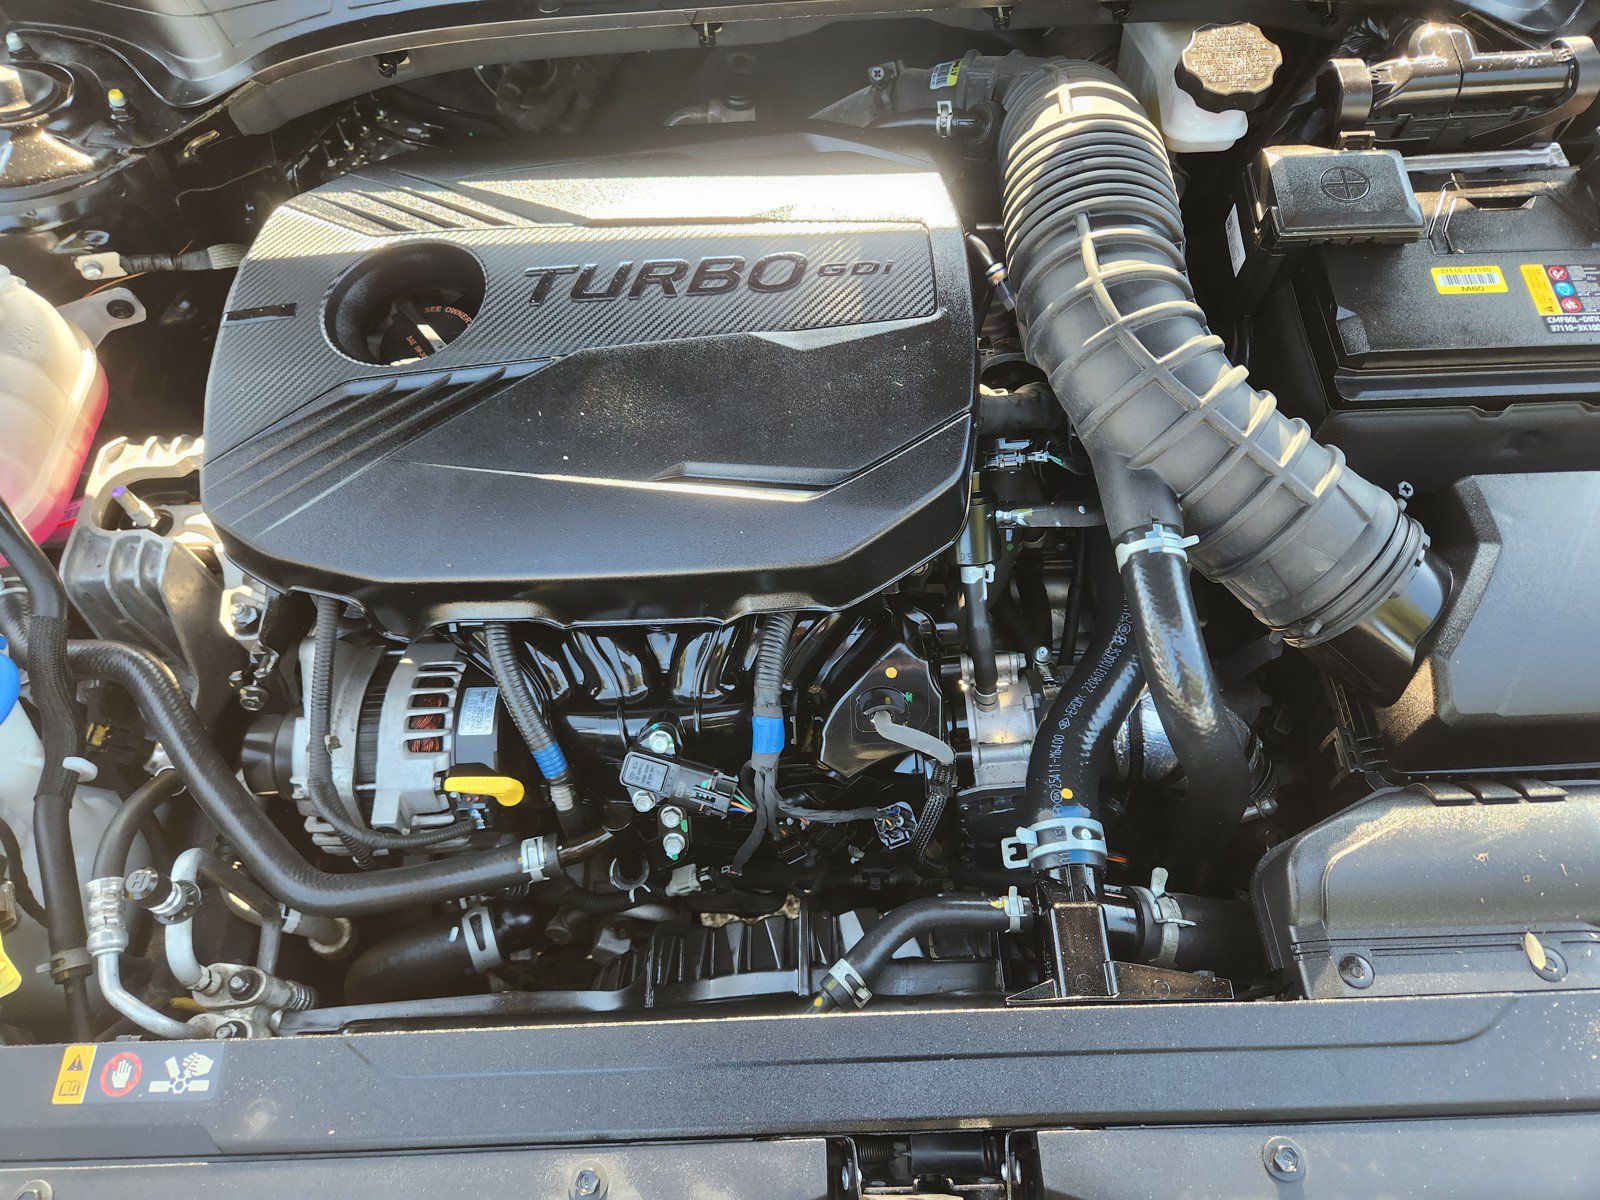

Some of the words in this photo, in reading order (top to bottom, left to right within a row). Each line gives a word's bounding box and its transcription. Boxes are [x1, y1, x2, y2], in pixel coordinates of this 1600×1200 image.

[524, 251, 808, 306] TURBO
[424, 305, 442, 314] SEE
[1048, 734, 1066, 789] 25411-M6400
